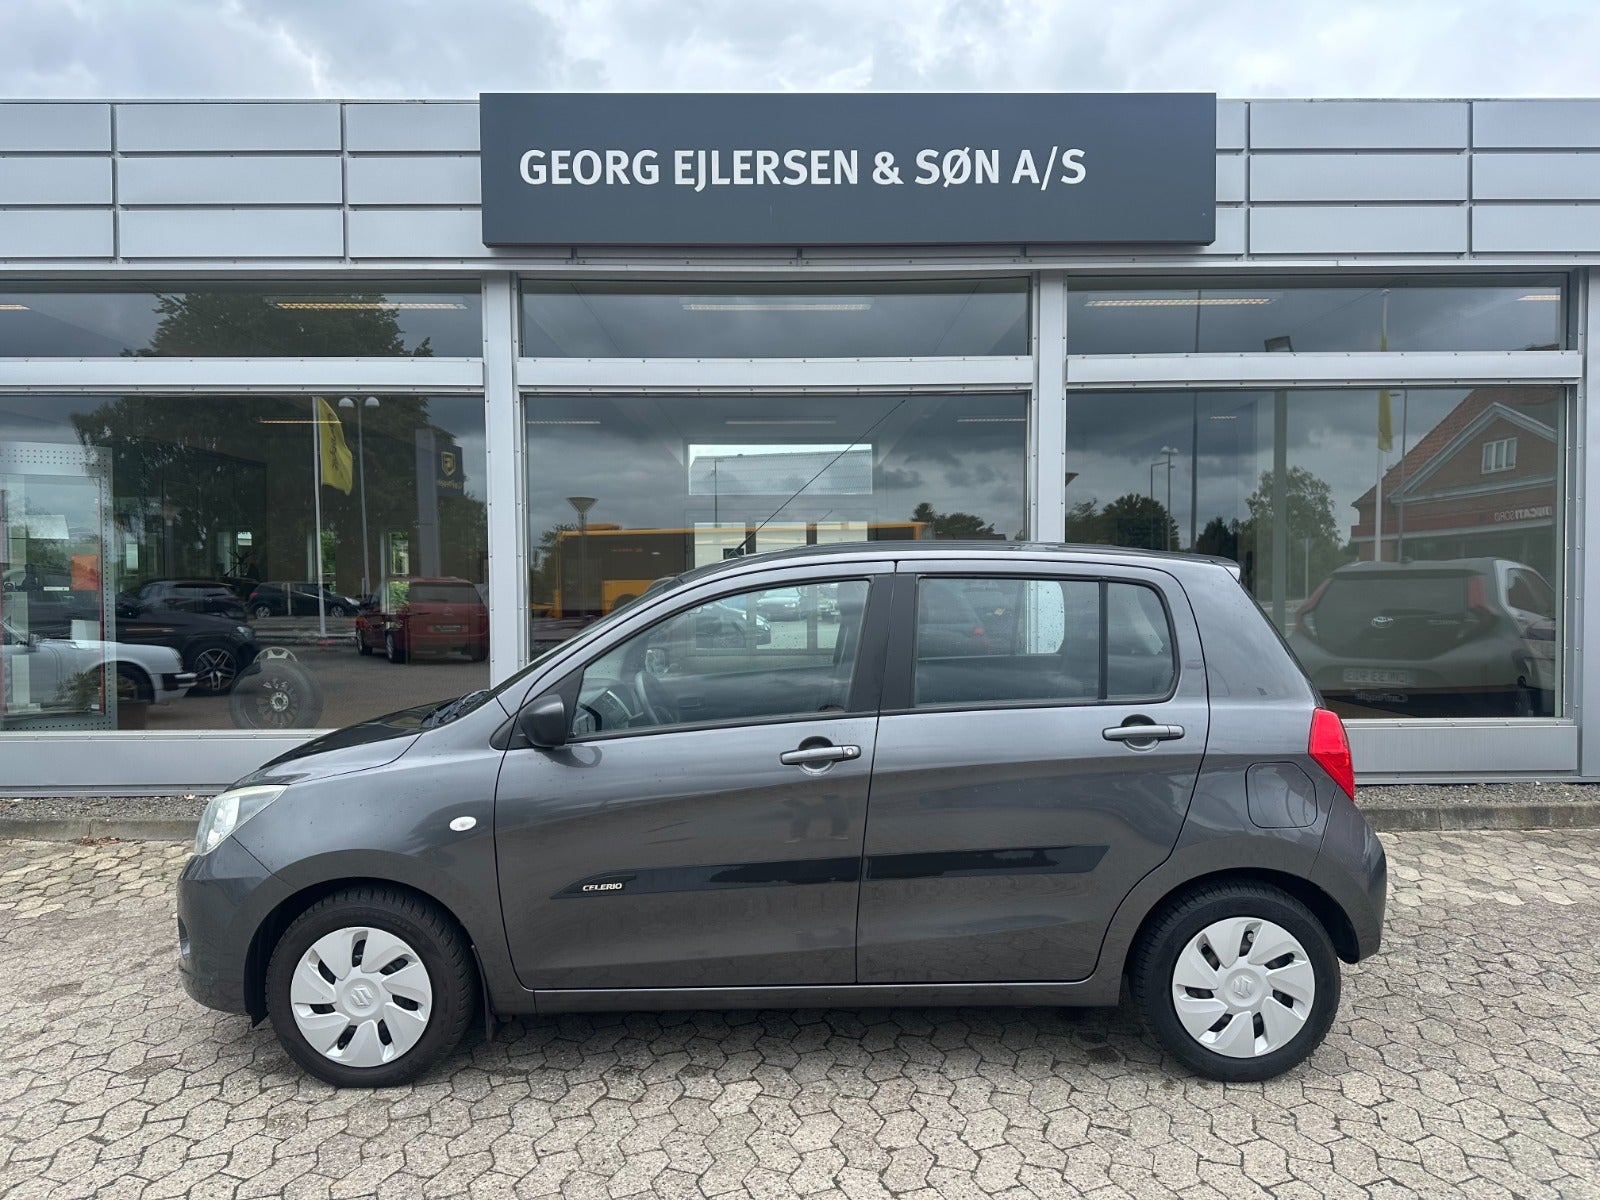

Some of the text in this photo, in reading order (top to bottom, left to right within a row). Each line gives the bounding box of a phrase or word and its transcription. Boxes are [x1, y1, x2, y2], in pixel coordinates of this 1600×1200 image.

[519, 146, 1087, 193] GEORG EJLERSEN & SØN A/S
[582, 882, 623, 892] CELERIO
